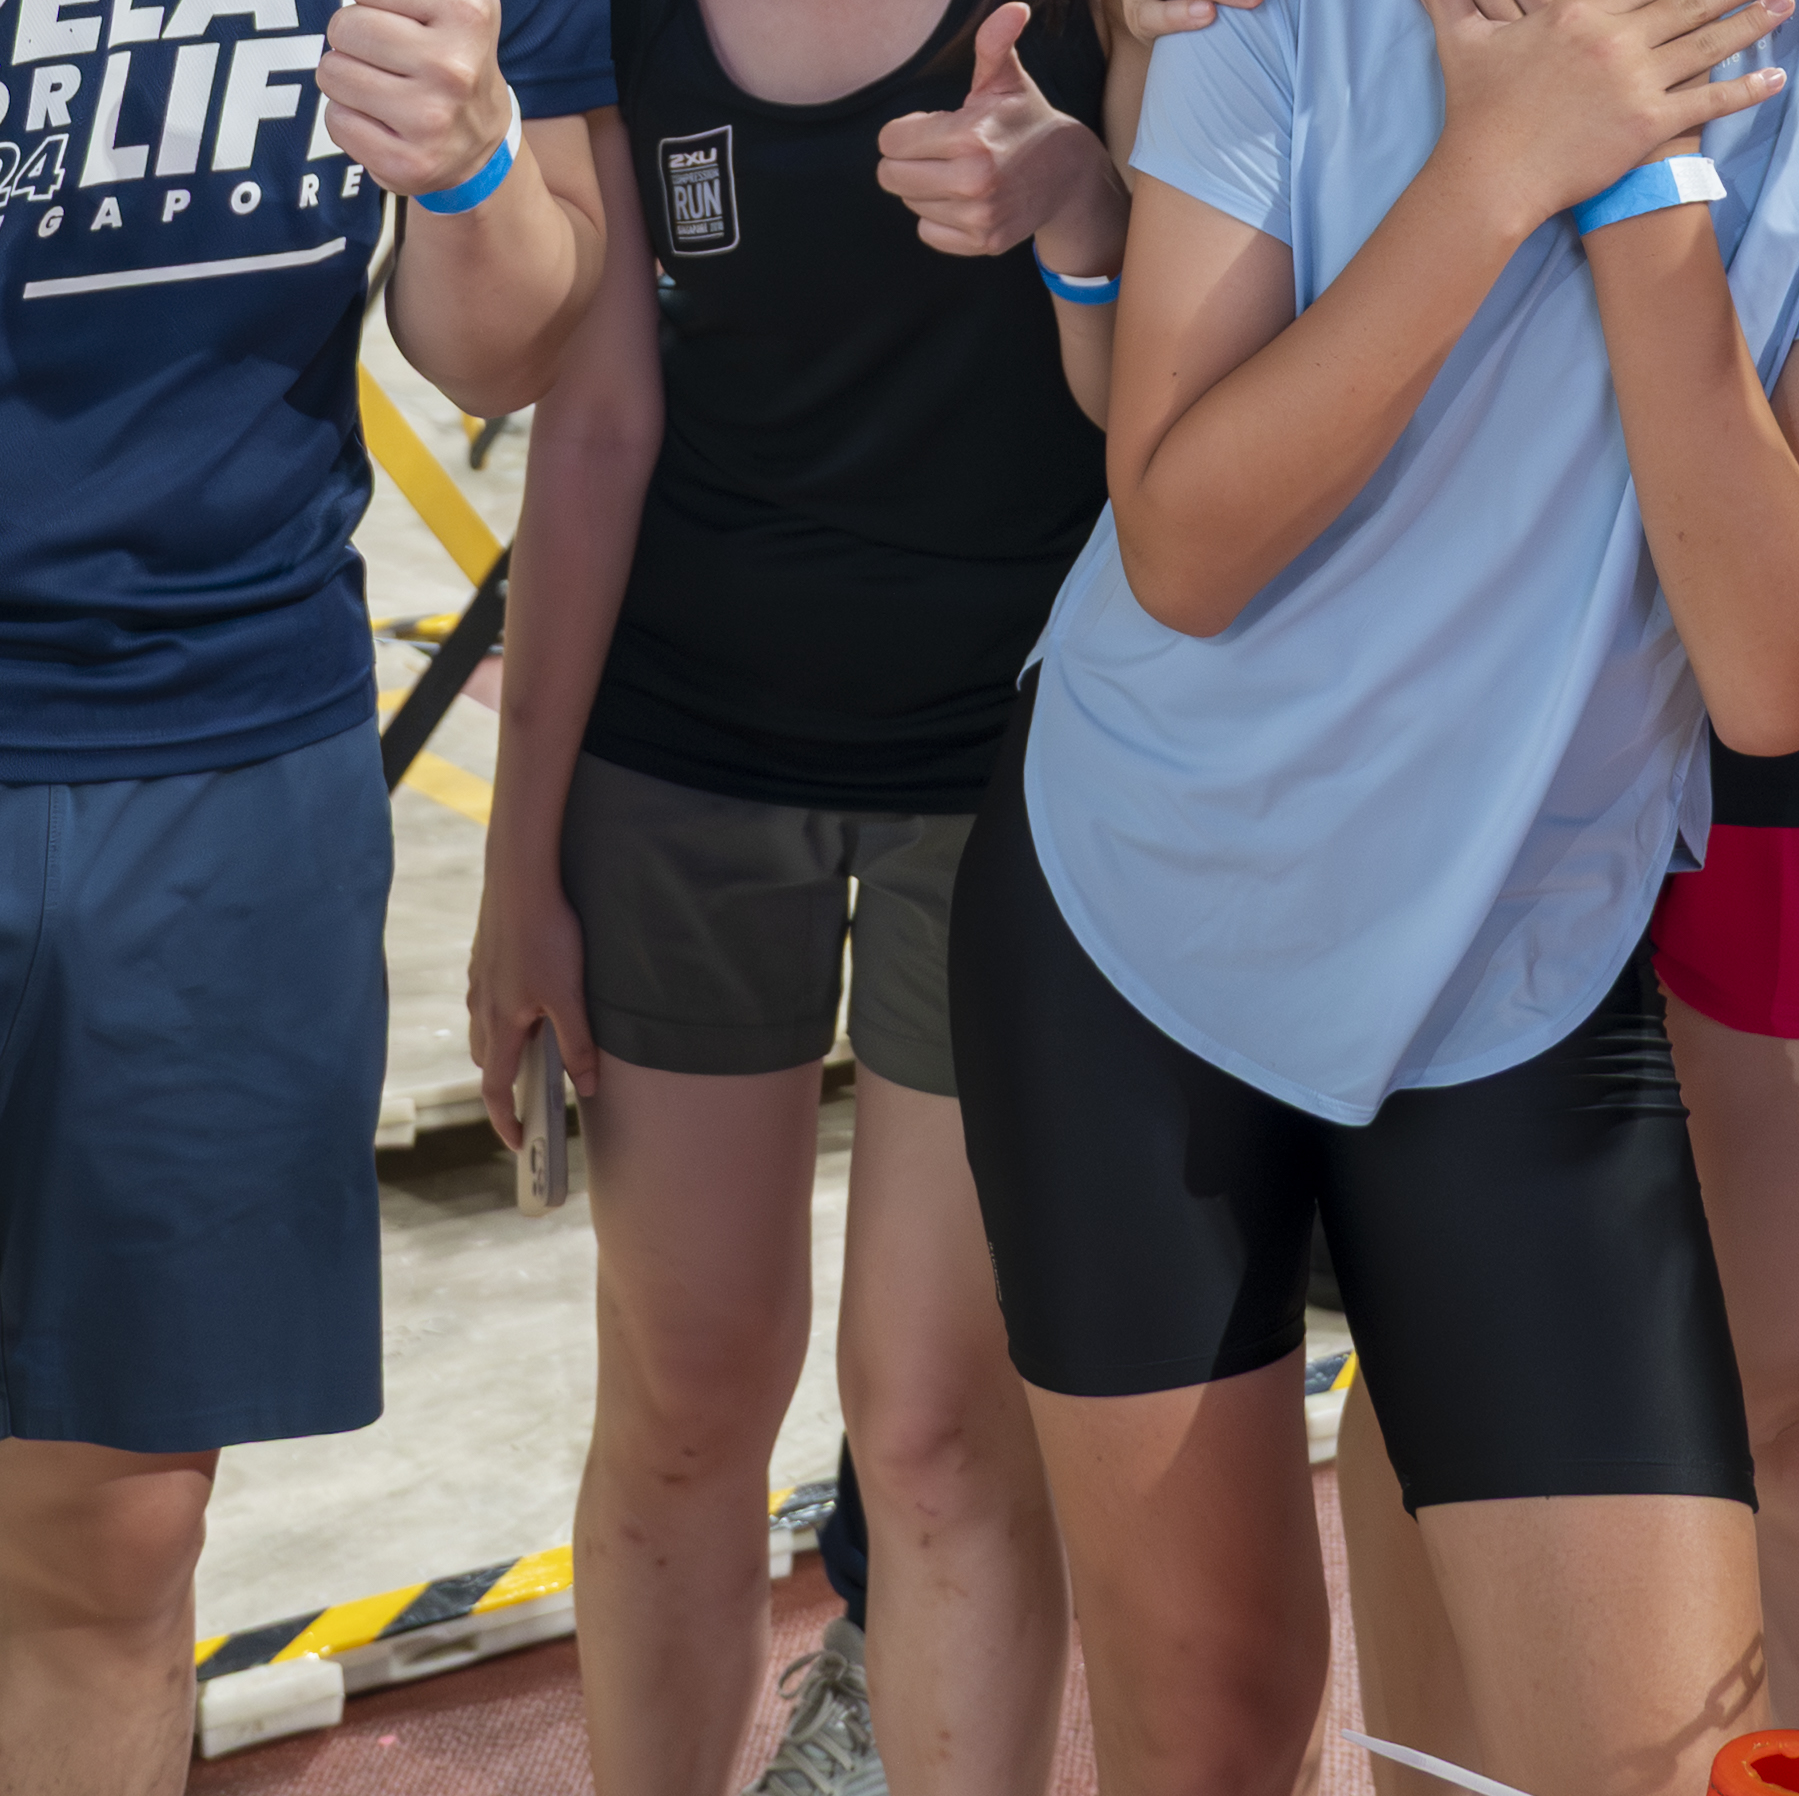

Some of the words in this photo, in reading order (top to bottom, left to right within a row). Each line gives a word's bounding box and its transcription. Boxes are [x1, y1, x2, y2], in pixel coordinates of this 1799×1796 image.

[80, 34, 347, 188] LIF
[668, 147, 717, 168] 2XU
[674, 178, 722, 220] RUN
